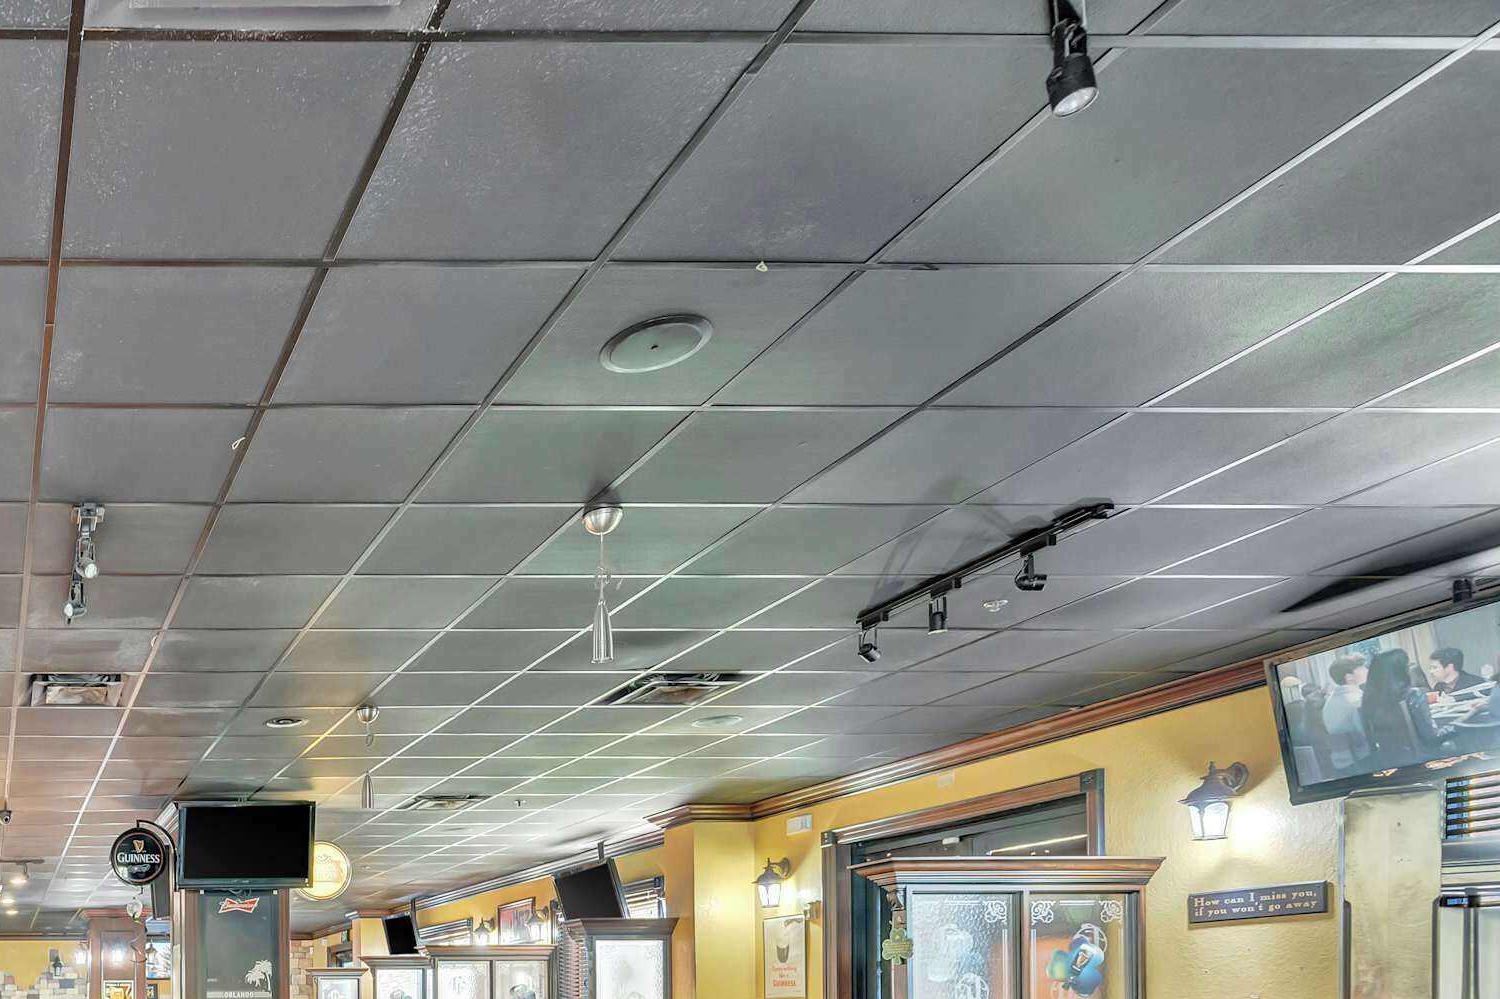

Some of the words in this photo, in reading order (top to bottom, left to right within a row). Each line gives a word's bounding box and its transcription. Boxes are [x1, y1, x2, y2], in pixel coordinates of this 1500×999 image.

[116, 852, 161, 864] GUINNESS
[1194, 897, 1220, 908] How
[1224, 896, 1245, 905] can
[1249, 892, 1256, 902] I
[1259, 891, 1287, 901] miss
[1195, 907, 1205, 917] if
[1207, 908, 1228, 917] you
[1231, 901, 1264, 913] won't
[1268, 903, 1281, 912] go
[1285, 900, 1317, 909] away
[224, 991, 254, 999] ORLANDO
